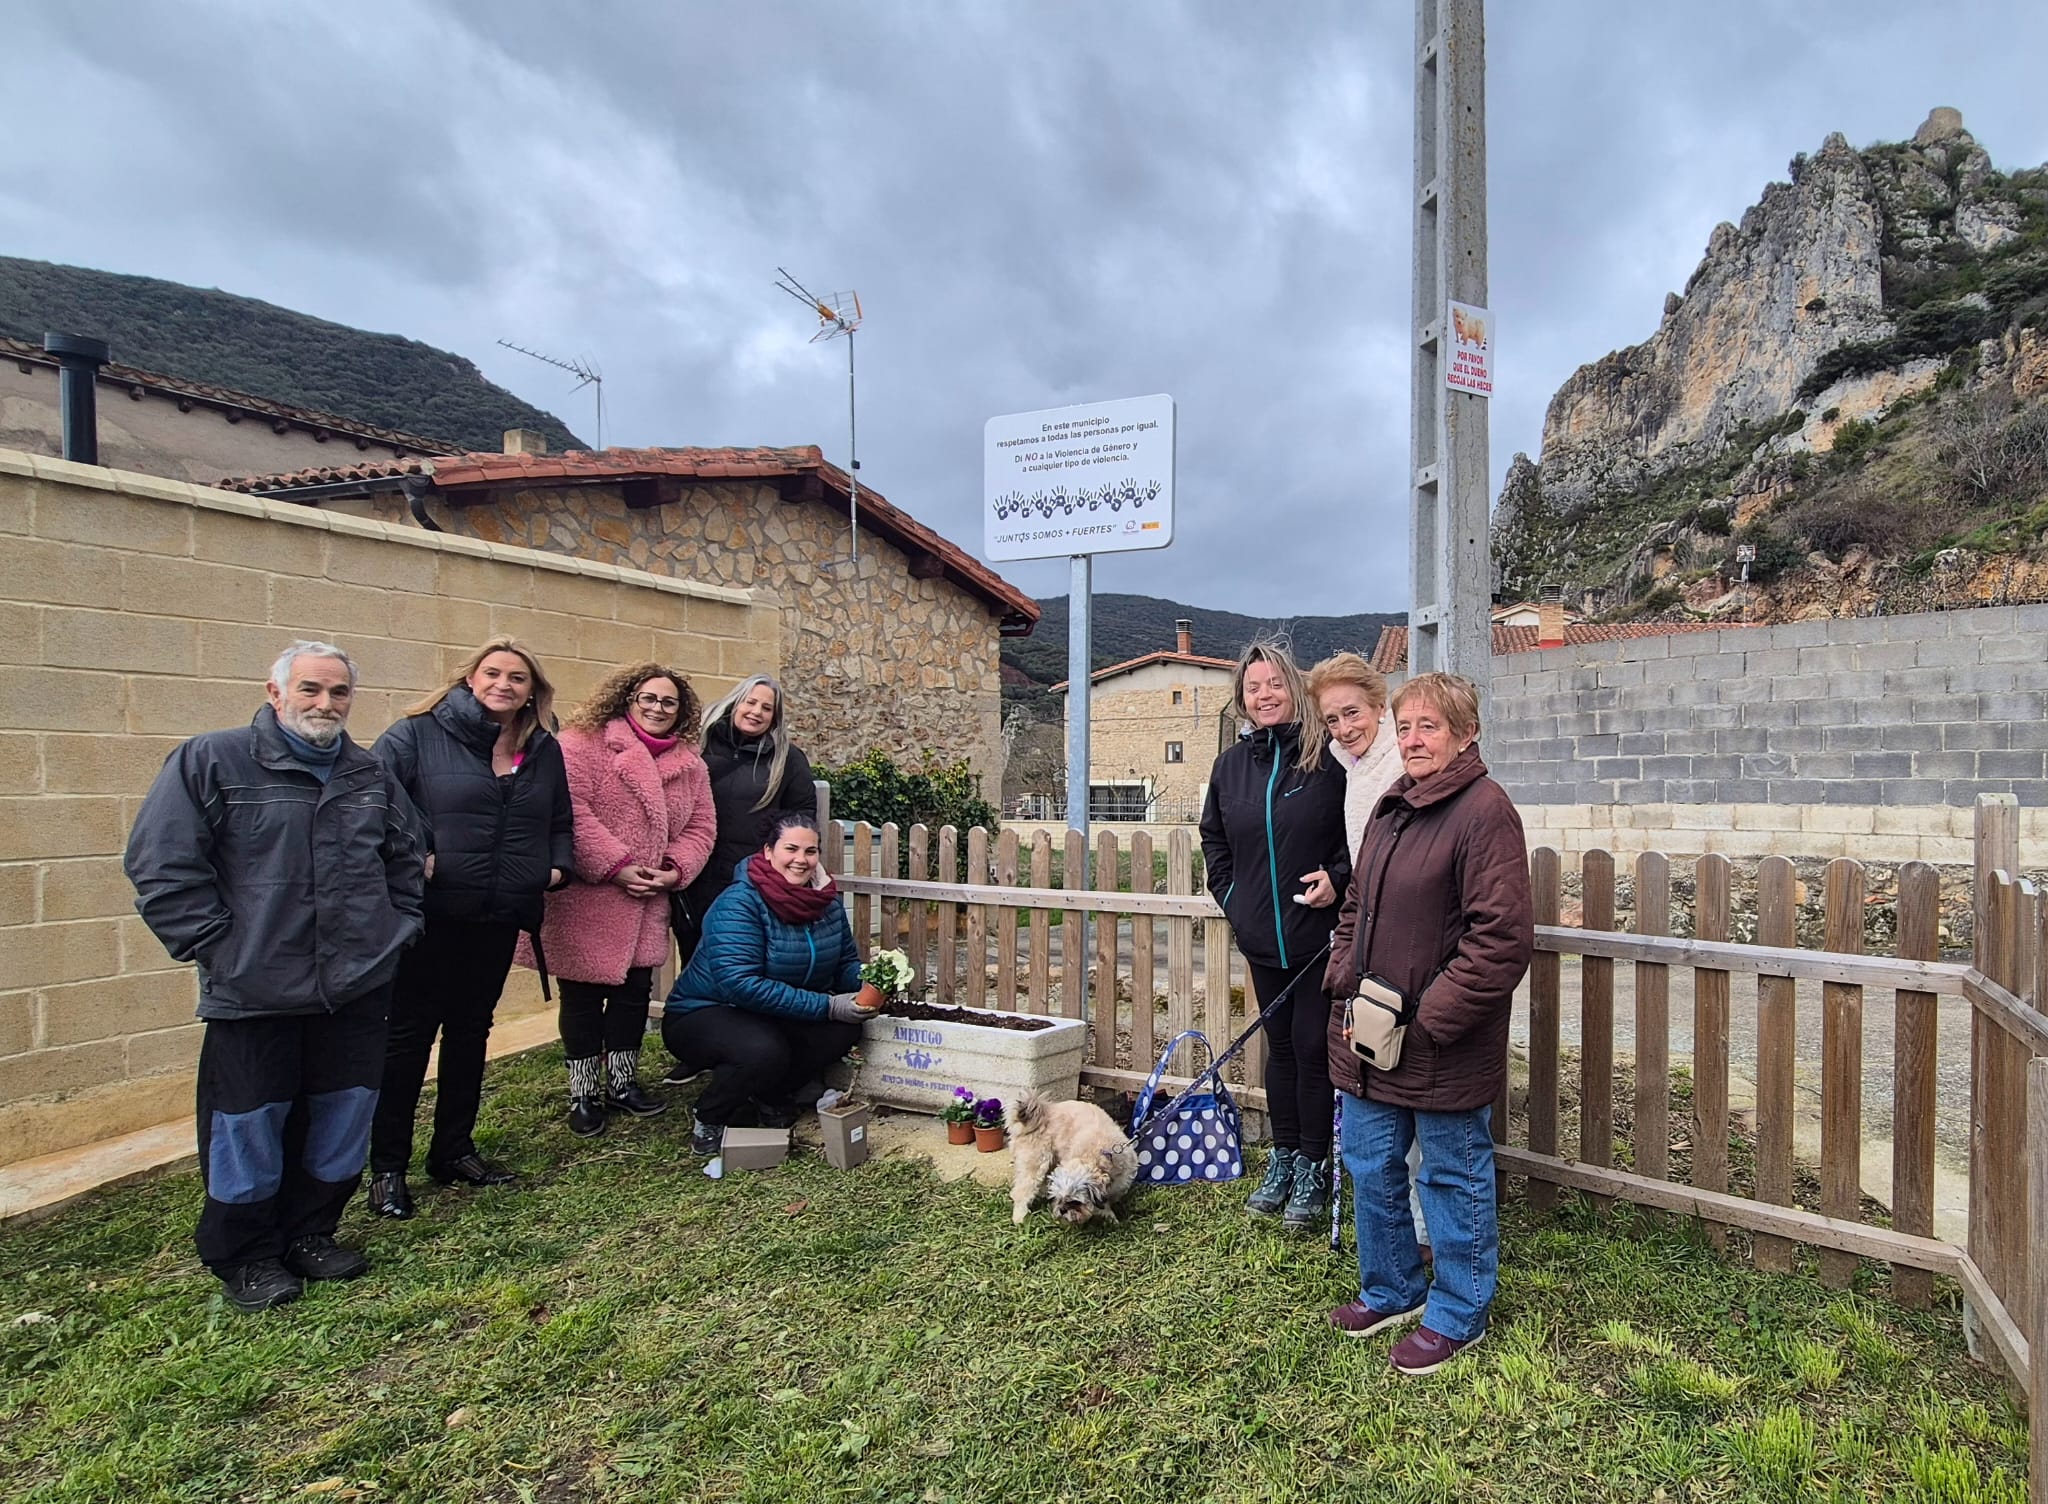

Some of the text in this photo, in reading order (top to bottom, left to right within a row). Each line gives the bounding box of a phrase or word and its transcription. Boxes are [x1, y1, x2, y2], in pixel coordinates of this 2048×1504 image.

[1458, 350, 1484, 364] POR FAVOR
[1453, 362, 1463, 372] QUE
[1464, 365, 1470, 374] EL
[1448, 373, 1492, 392] RECOJA LAS HECES
[1042, 417, 1110, 432] En este municipio
[996, 436, 1040, 450] respetamos
[1048, 432, 1068, 442] todas
[1084, 427, 1120, 440] personas
[1121, 425, 1134, 435] por
[1136, 420, 1158, 432] igual.
[1024, 452, 1038, 462] NO
[1054, 448, 1089, 458] Violencia
[1090, 446, 1100, 454] de
[1102, 442, 1130, 452] Género
[1132, 442, 1138, 450] y
[1028, 462, 1063, 472] cualquier
[1064, 458, 1080, 469] tipo
[1082, 458, 1091, 466] de
[1032, 530, 1064, 540] SOMOS
[893, 1026, 942, 1045] AMEYUGO
